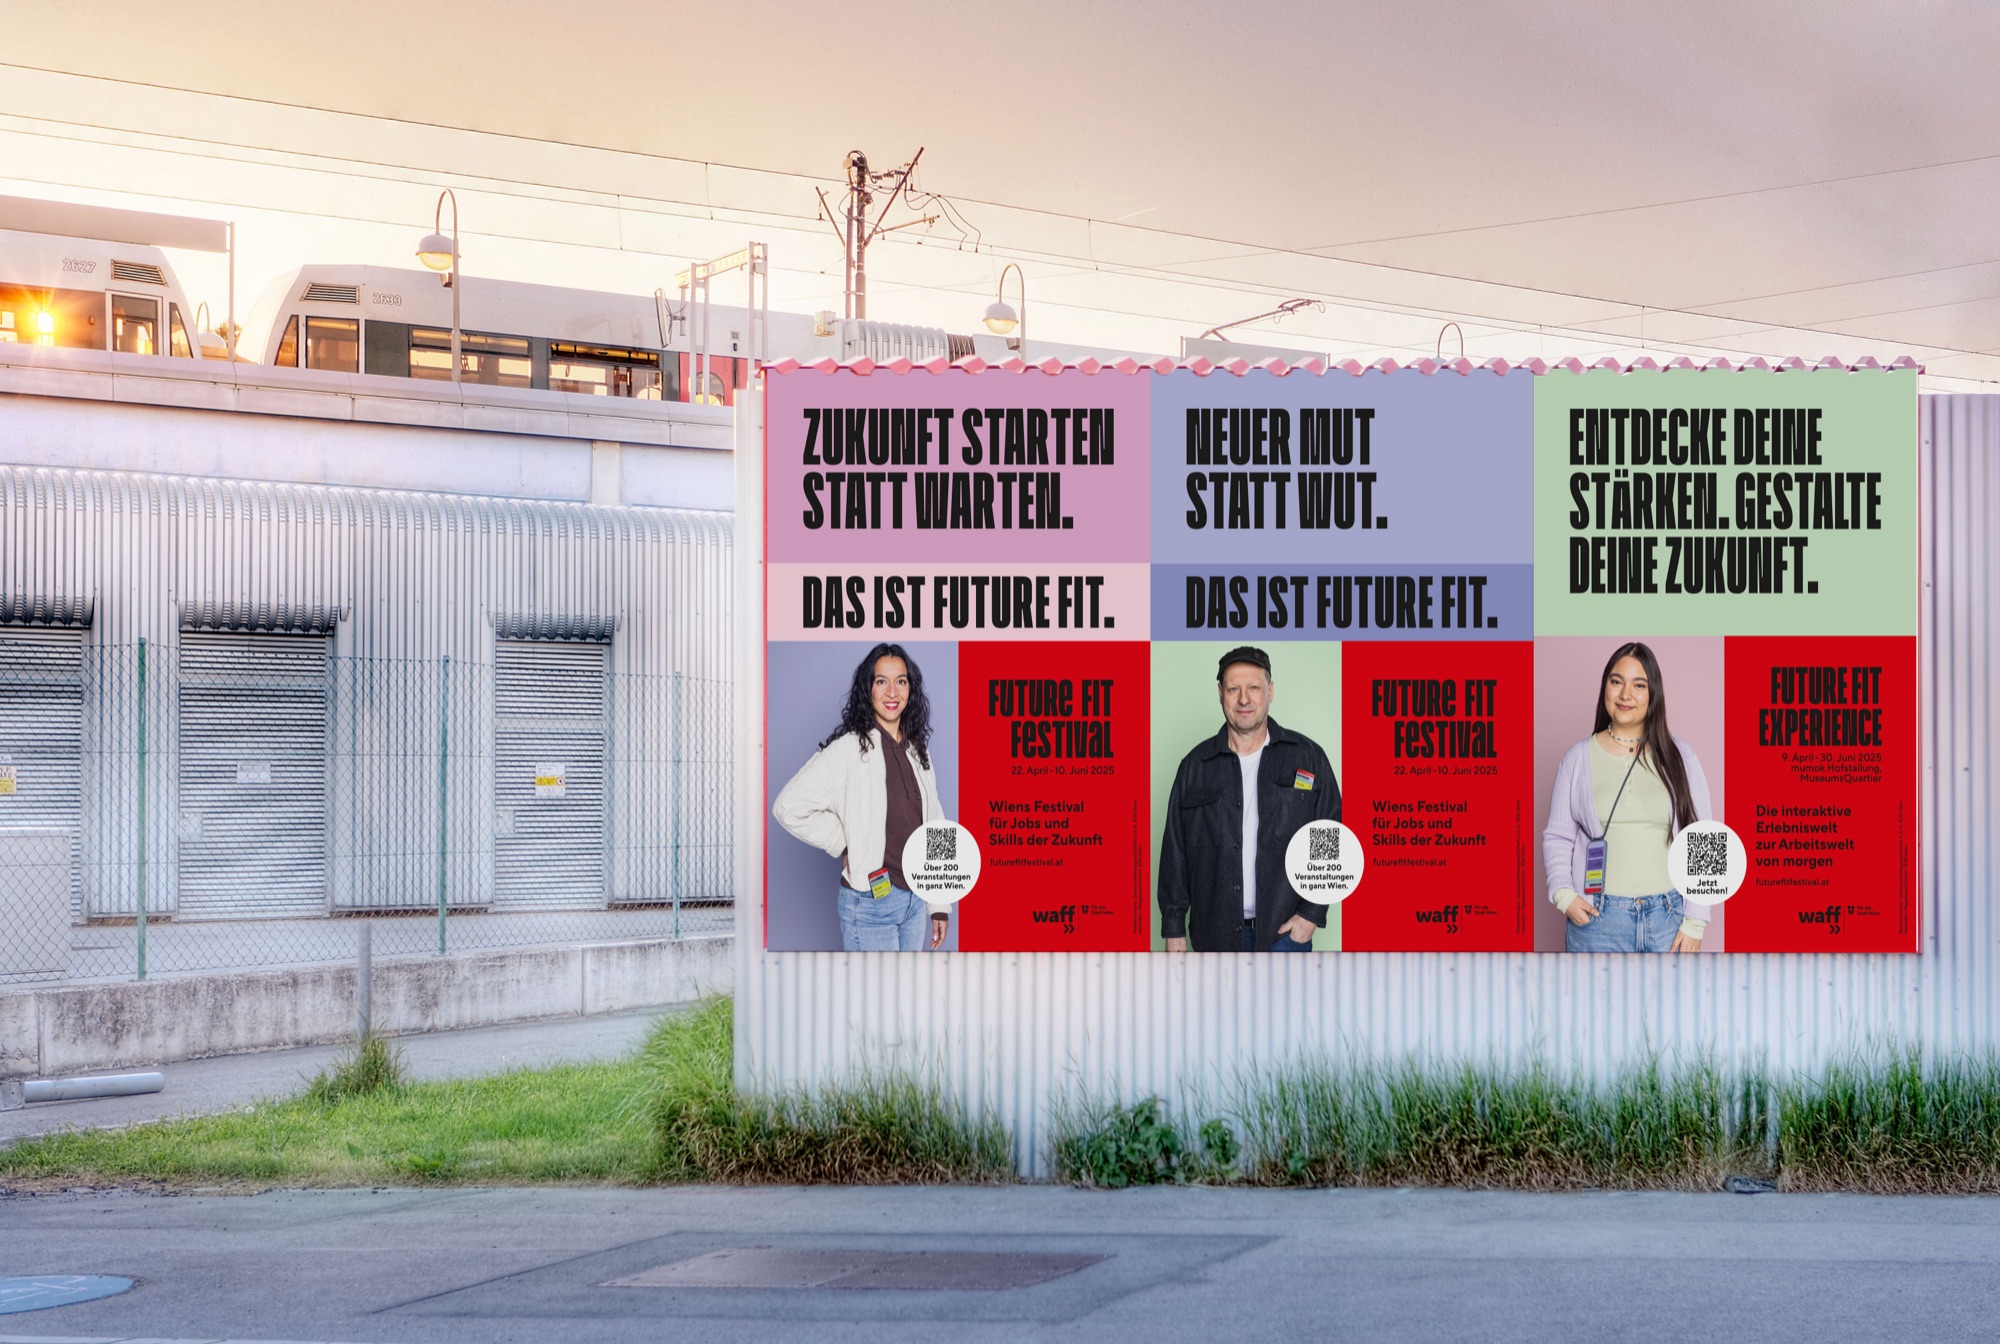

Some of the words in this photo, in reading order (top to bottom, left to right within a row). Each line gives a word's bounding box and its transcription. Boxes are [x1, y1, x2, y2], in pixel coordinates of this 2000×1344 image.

[62, 259, 97, 274] 2627
[372, 293, 402, 306] 2633
[802, 408, 955, 466] ZUKUNFT
[961, 407, 1115, 466] STARTEN
[1186, 408, 1292, 466] NEUER
[1299, 408, 1376, 466] MUT
[1569, 408, 1727, 466] ENTDECKE
[1733, 408, 1823, 466] DEINE
[802, 471, 908, 530] STATT
[914, 471, 1074, 530] WARTEN.
[1186, 471, 1291, 530] STATT
[1297, 471, 1388, 530] WUT.
[1569, 468, 1730, 530] STÄRKEN.
[1735, 471, 1882, 530] GESTALTE
[1569, 536, 1658, 594] DEINE
[1665, 536, 1819, 594] ZUKUNFT.
[802, 575, 866, 629] DAS
[873, 575, 926, 629] IST
[933, 575, 1050, 629] FUTURE
[1058, 575, 1115, 629] FIT.
[1186, 575, 1249, 629] DAS
[1256, 575, 1309, 629] IST
[1316, 575, 1434, 629] FUTURE
[1441, 575, 1499, 629] FIT.
[1770, 666, 1848, 705] FUTURE
[1851, 666, 1883, 705] FIT
[1081, 679, 1115, 718] FIT
[1464, 679, 1498, 718] FIT
[1758, 708, 1883, 747] EXPERIENCE
[1781, 753, 1790, 762] 9.
[1792, 753, 1814, 764] April
[1820, 753, 1835, 762] 30.
[1836, 753, 1856, 762] Juni
[1858, 753, 1882, 762] 2025
[1011, 765, 1025, 776] 22.
[1026, 765, 1049, 777] April
[1055, 765, 1068, 776] 10.
[1069, 765, 1089, 776] Juni
[1090, 765, 1115, 776] 2025
[1394, 765, 1408, 776] 22.
[1409, 765, 1432, 777] April
[1438, 765, 1451, 776] 10.
[1452, 765, 1472, 776] Juni
[1473, 765, 1498, 776] 2025
[1791, 763, 1825, 773] mumok
[1827, 763, 1882, 774] Hofstallung,
[1800, 773, 1882, 784] MuseumsQuartier
[989, 800, 1031, 813] Wiens
[1034, 800, 1085, 813] Festival
[1372, 800, 1414, 813] Wiens
[1417, 800, 1468, 813] Festival
[1756, 805, 1779, 817] Die
[1781, 805, 1852, 817] interaktive
[989, 817, 1008, 829] für
[1010, 817, 1041, 829] Jobs
[1044, 817, 1070, 829] und
[1372, 817, 1391, 829] für
[1393, 817, 1424, 829] Jobs
[1427, 817, 1453, 829] und
[1756, 821, 1838, 834] Erlebniswelt
[989, 833, 1024, 846] Skills
[1026, 833, 1049, 846] der
[1051, 833, 1103, 846] Zukunft
[1372, 833, 1407, 846] Skills
[1409, 833, 1432, 846] der
[1434, 833, 1486, 846] Zukunft
[1755, 839, 1777, 850] zur
[1778, 838, 1855, 850] Arbeitswelt
[924, 862, 942, 871] Über
[989, 857, 1063, 867] futurefitfestival.at
[1307, 862, 1325, 871] Über
[1372, 857, 1446, 867] futurefitfestival.at
[1755, 857, 1780, 867] von
[1783, 857, 1833, 870] morgen
[911, 873, 971, 882] Veranstaltungen
[1294, 873, 1354, 882] Veranstaltungen
[1697, 879, 1718, 887] Jetzt
[1755, 878, 1829, 887] futurefitfestival.at
[925, 883, 943, 891] ganz
[1308, 883, 1326, 891] ganz
[1686, 886, 1728, 895] besuchen!
[1032, 904, 1077, 923] waff
[1415, 904, 1460, 923] waff
[1798, 905, 1842, 923] waff
